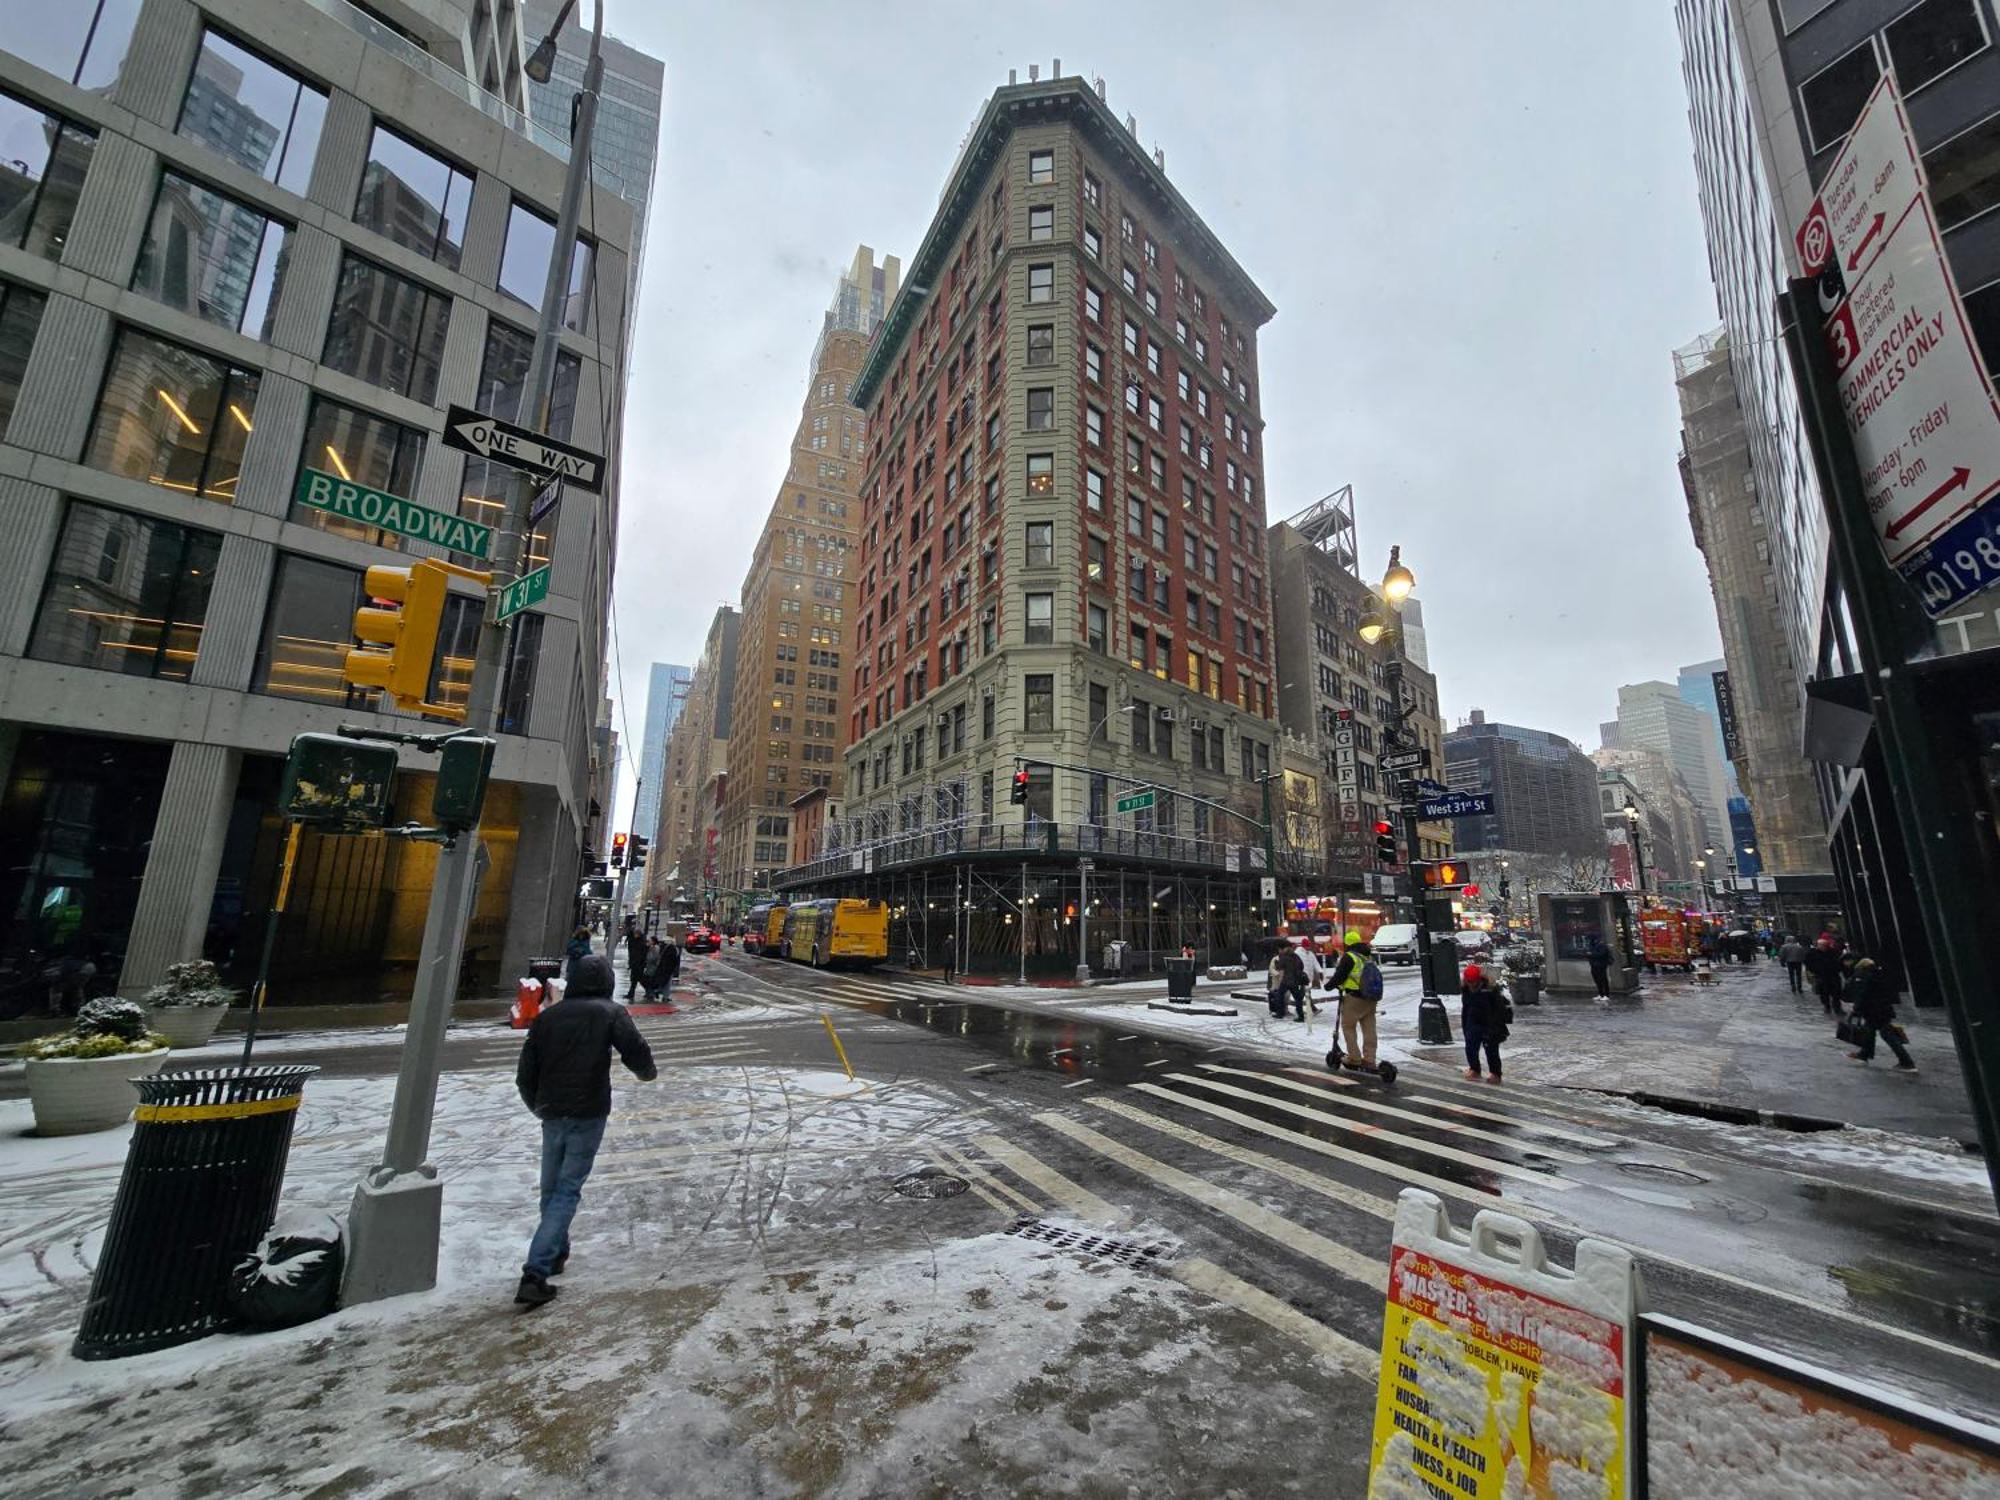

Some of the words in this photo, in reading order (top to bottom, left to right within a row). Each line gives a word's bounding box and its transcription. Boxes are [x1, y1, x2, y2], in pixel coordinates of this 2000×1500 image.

[1827, 154, 1858, 209] Tuesday
[1832, 183, 1856, 226] Friday
[1839, 201, 1869, 251] 5:30am
[1875, 160, 1895, 194] 6am
[1854, 282, 1873, 313] hour
[1858, 272, 1895, 327] metered
[1862, 297, 1896, 346] parking
[1831, 319, 1850, 369] 3
[1842, 305, 1923, 409] COMMERCIAL
[1848, 360, 1905, 434] VEHICLES
[1906, 310, 1944, 368] ONLY
[472, 425, 520, 456] ONE
[539, 447, 586, 477] WAY
[1862, 446, 1902, 494] Monday
[1909, 400, 1950, 447] Friday
[1868, 487, 1894, 514] 8am
[1899, 457, 1927, 488] 6pm
[308, 474, 488, 554] BROADWAY
[502, 588, 514, 615] W
[516, 579, 531, 608] 31
[535, 573, 544, 588] ST
[1337, 732, 1357, 818] GIFTS
[1426, 803, 1452, 816] West
[1454, 801, 1472, 813] 31st
[1474, 799, 1486, 811] St
[1400, 1295, 1431, 1314] MOST
[1402, 1314, 1409, 1325] IF
[1511, 1362, 1538, 1384] HAVE
[1394, 1409, 1429, 1443] HEALTH
[1432, 1432, 1440, 1449] &
[1446, 1467, 1453, 1485] &
[1456, 1471, 1477, 1497] JOB
